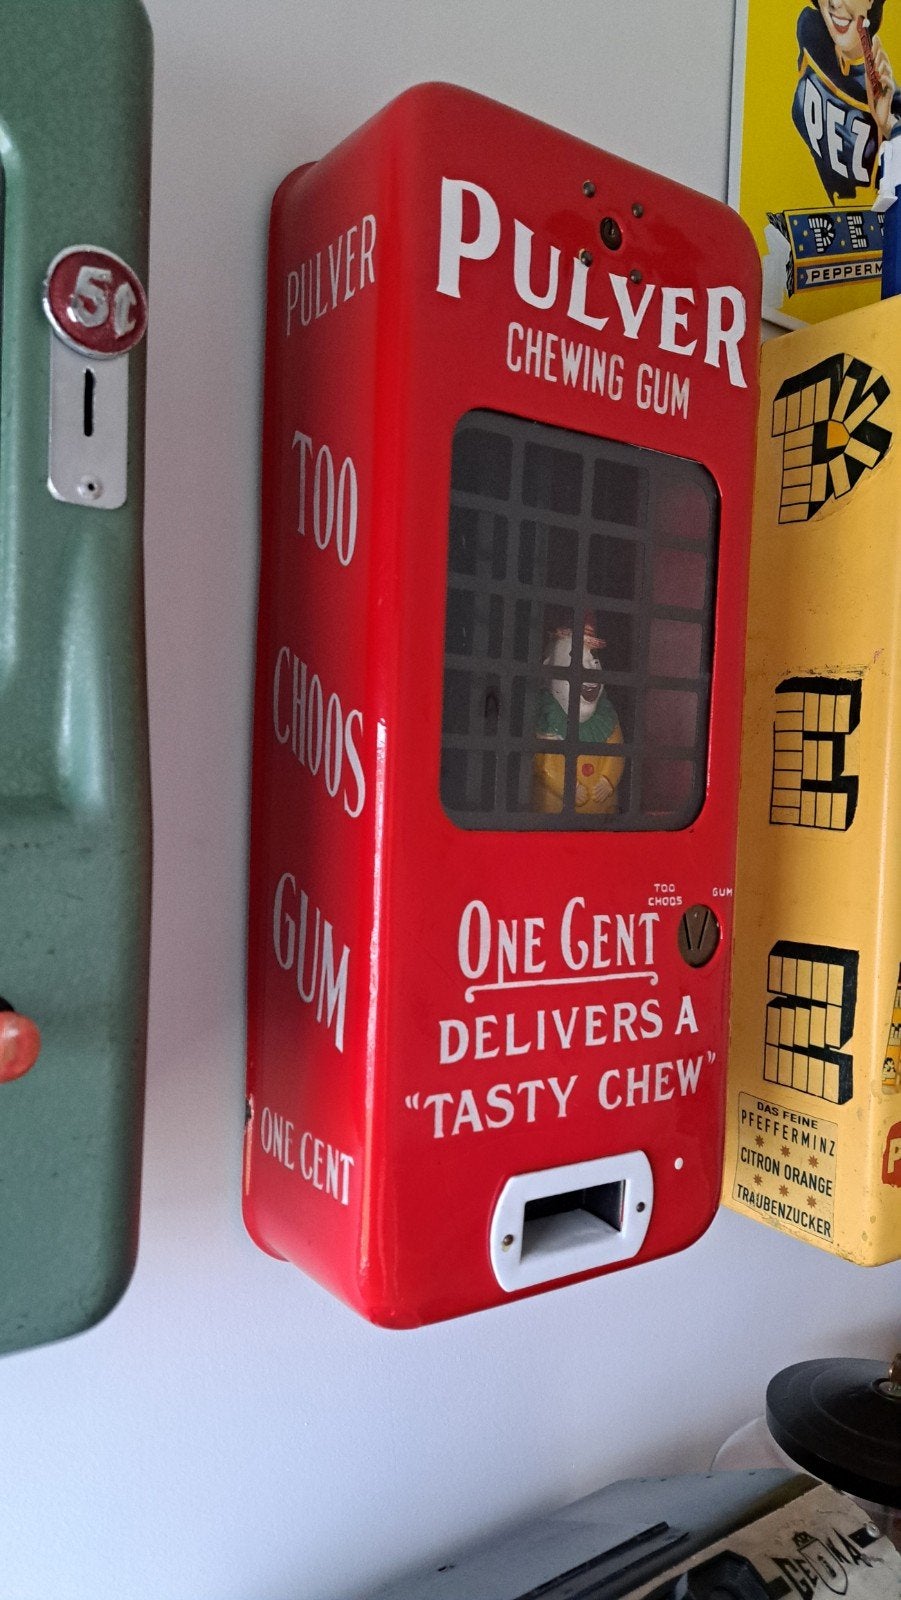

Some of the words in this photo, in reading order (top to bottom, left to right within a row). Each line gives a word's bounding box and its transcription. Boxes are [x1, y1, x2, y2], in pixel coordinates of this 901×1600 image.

[804, 77, 871, 183] PEZ
[286, 214, 377, 336] PULVER
[436, 176, 747, 388] PULVER
[506, 321, 624, 401] CHEWING
[636, 363, 690, 420] GUM
[291, 430, 358, 567] TOO
[273, 646, 365, 819] CHOOS
[648, 896, 682, 907] CHOOS
[653, 883, 676, 893] TOO
[712, 887, 733, 897] GUM
[273, 871, 350, 1053] GUM
[458, 900, 546, 984] ONE
[560, 896, 660, 970] CENT
[438, 999, 663, 1065] DELIVERS
[674, 995, 699, 1036] A
[260, 1106, 295, 1184] ONE
[300, 1130, 355, 1206] CENT
[741, 1109, 836, 1157] PFEFFERMINZ
[756, 1101, 779, 1117] DAS
[783, 1111, 819, 1130] FEINE
[737, 1183, 831, 1238] TRAUBENZUCKER
[740, 1146, 780, 1177] CITRON
[784, 1164, 833, 1197] ORANGE
